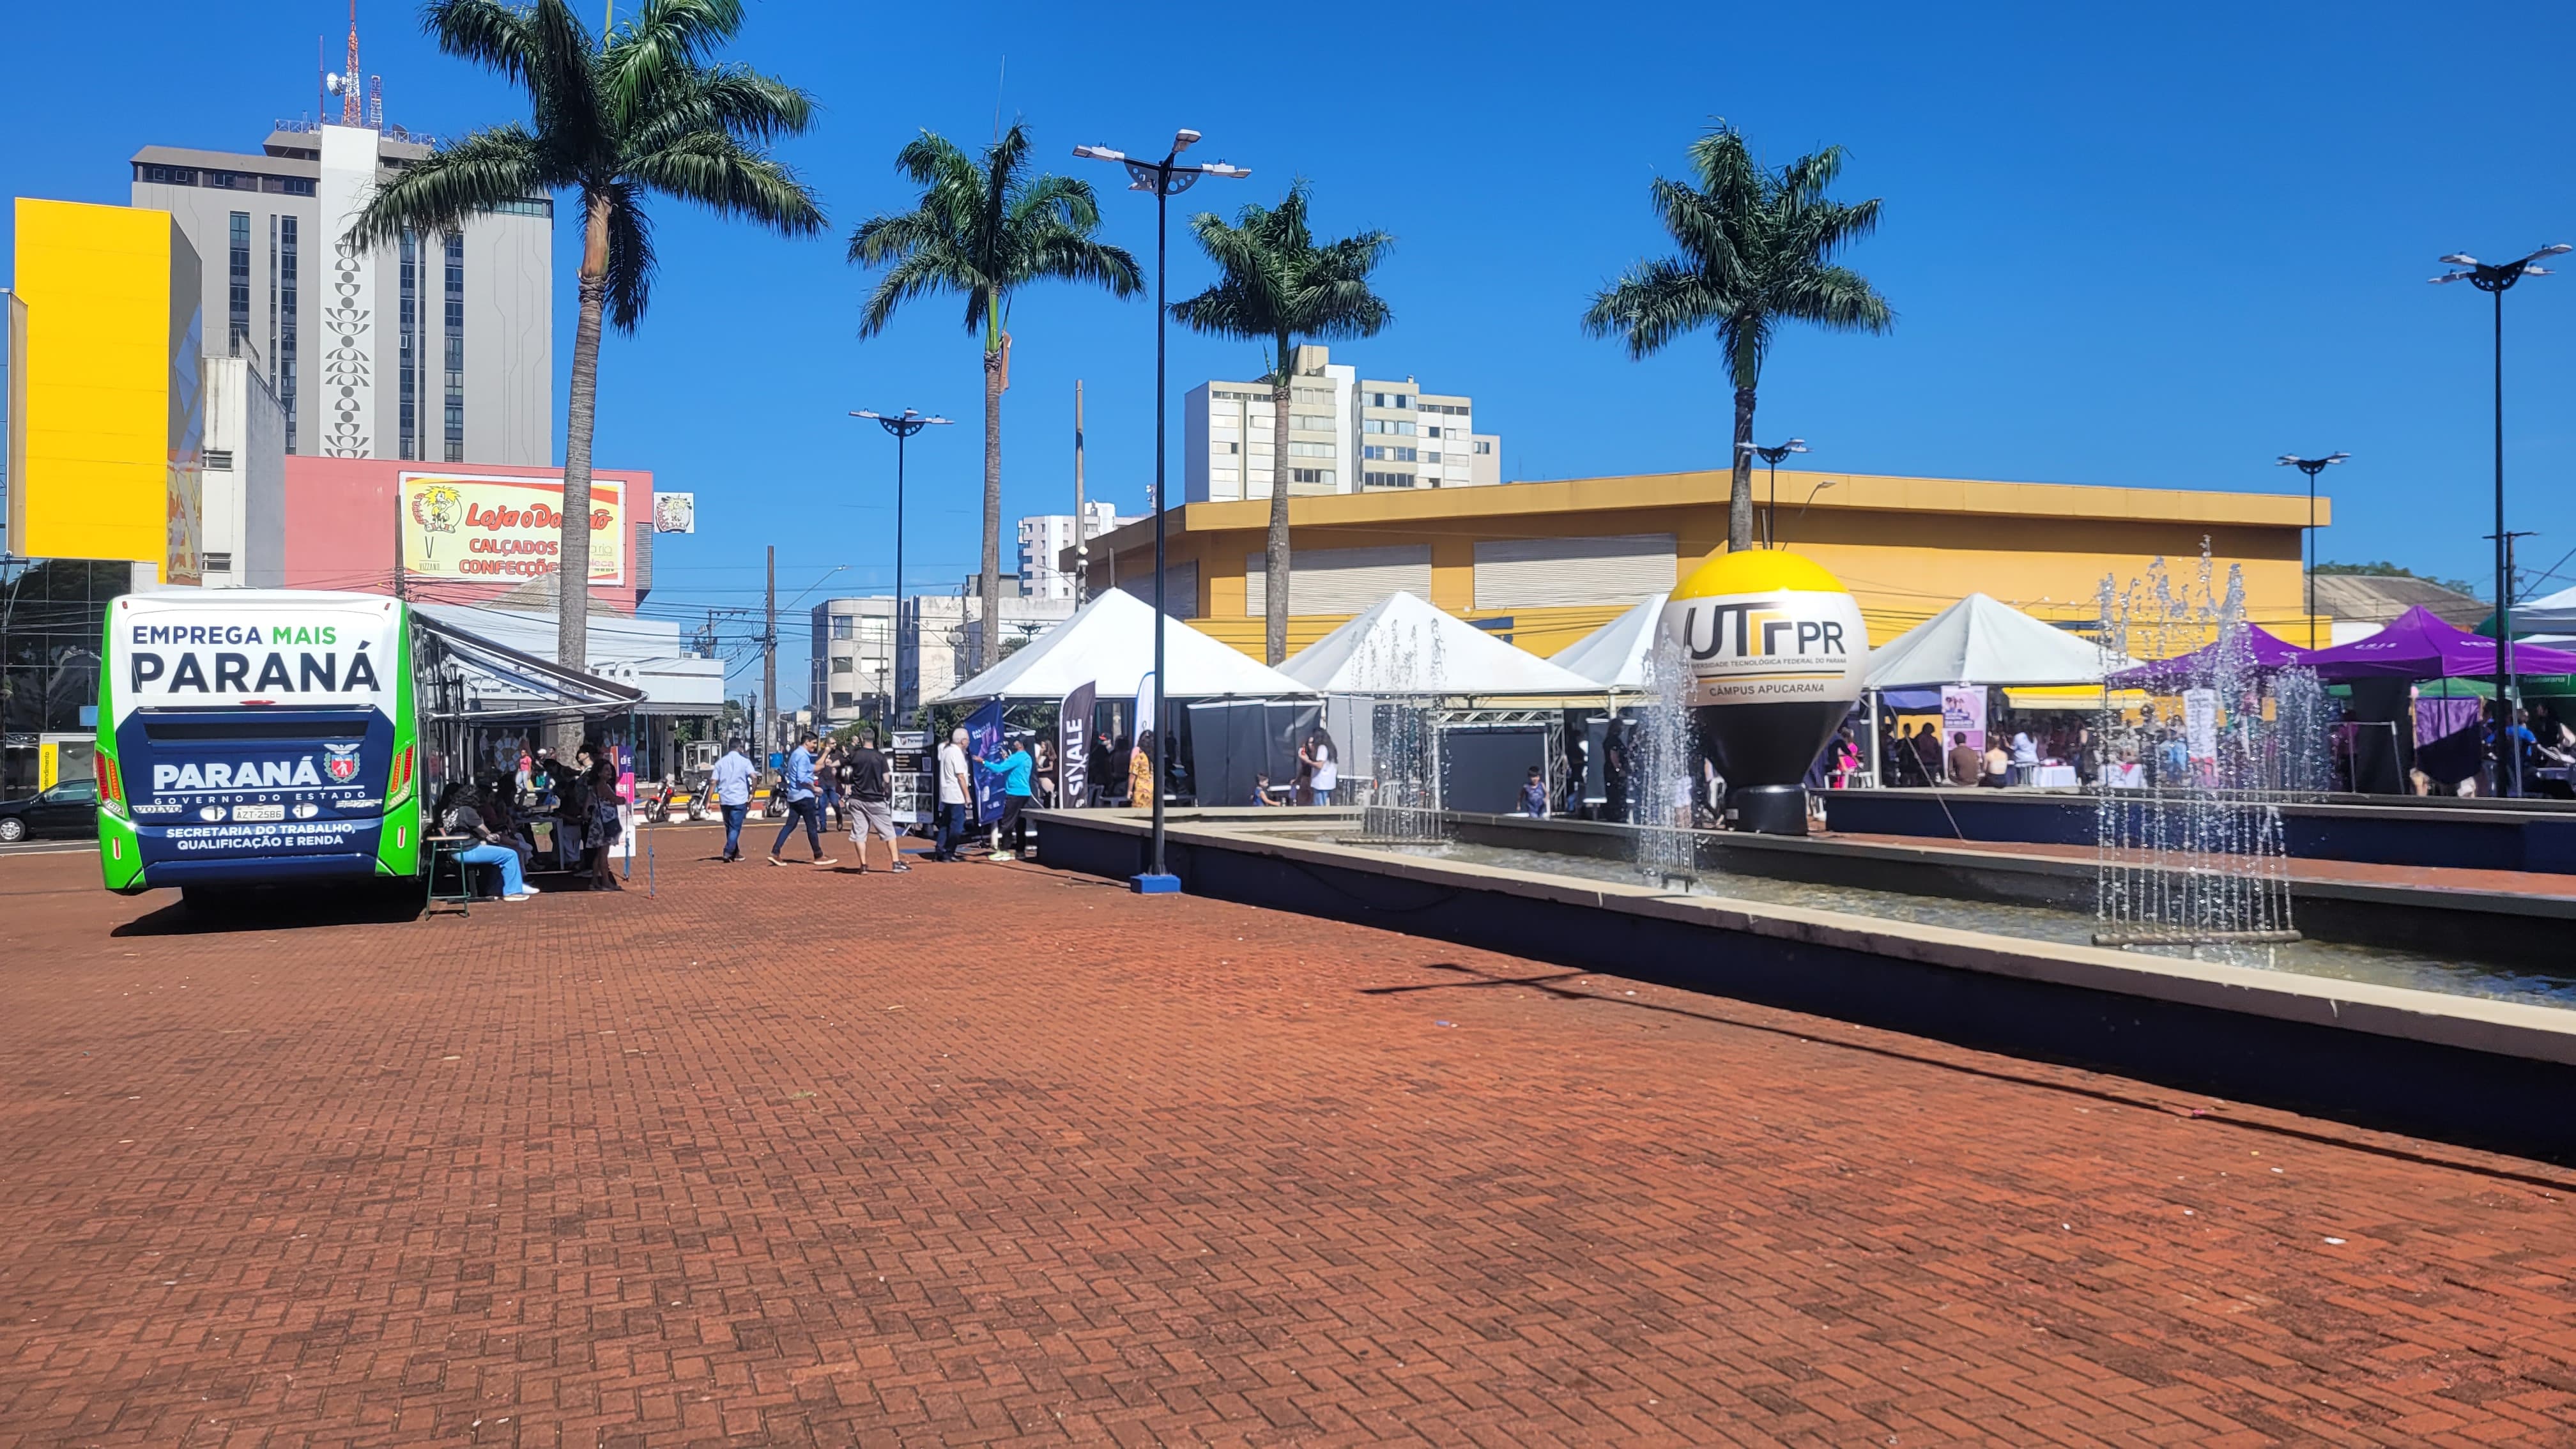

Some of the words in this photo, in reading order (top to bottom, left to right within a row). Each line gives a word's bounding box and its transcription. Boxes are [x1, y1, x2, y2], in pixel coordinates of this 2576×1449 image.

[465, 503, 519, 531] Loja
[520, 510, 534, 528] o
[470, 538, 558, 556] CALÇADOS
[133, 625, 263, 645] EMPREGA
[273, 626, 337, 645] MAIS
[1683, 601, 1846, 660] UTFPR
[132, 640, 381, 693] PARANÁ
[1731, 658, 1781, 666] TECNOLÓGICA
[1710, 685, 1754, 696] CÂMPUS
[1758, 683, 1824, 694] APUCARANA
[1065, 718, 1089, 796] SIVALE
[154, 756, 321, 789] PARANÁ
[155, 795, 243, 805] GOVERNO
[296, 791, 365, 800] ESTADO
[133, 804, 182, 813] VOLVO
[166, 826, 250, 838] SECRETARIA
[256, 825, 276, 834] DO
[280, 824, 355, 834] TRABALHO,
[177, 836, 282, 850] QUALIFICAÇÃO
[285, 836, 294, 846] E
[297, 835, 344, 846] RENDA
